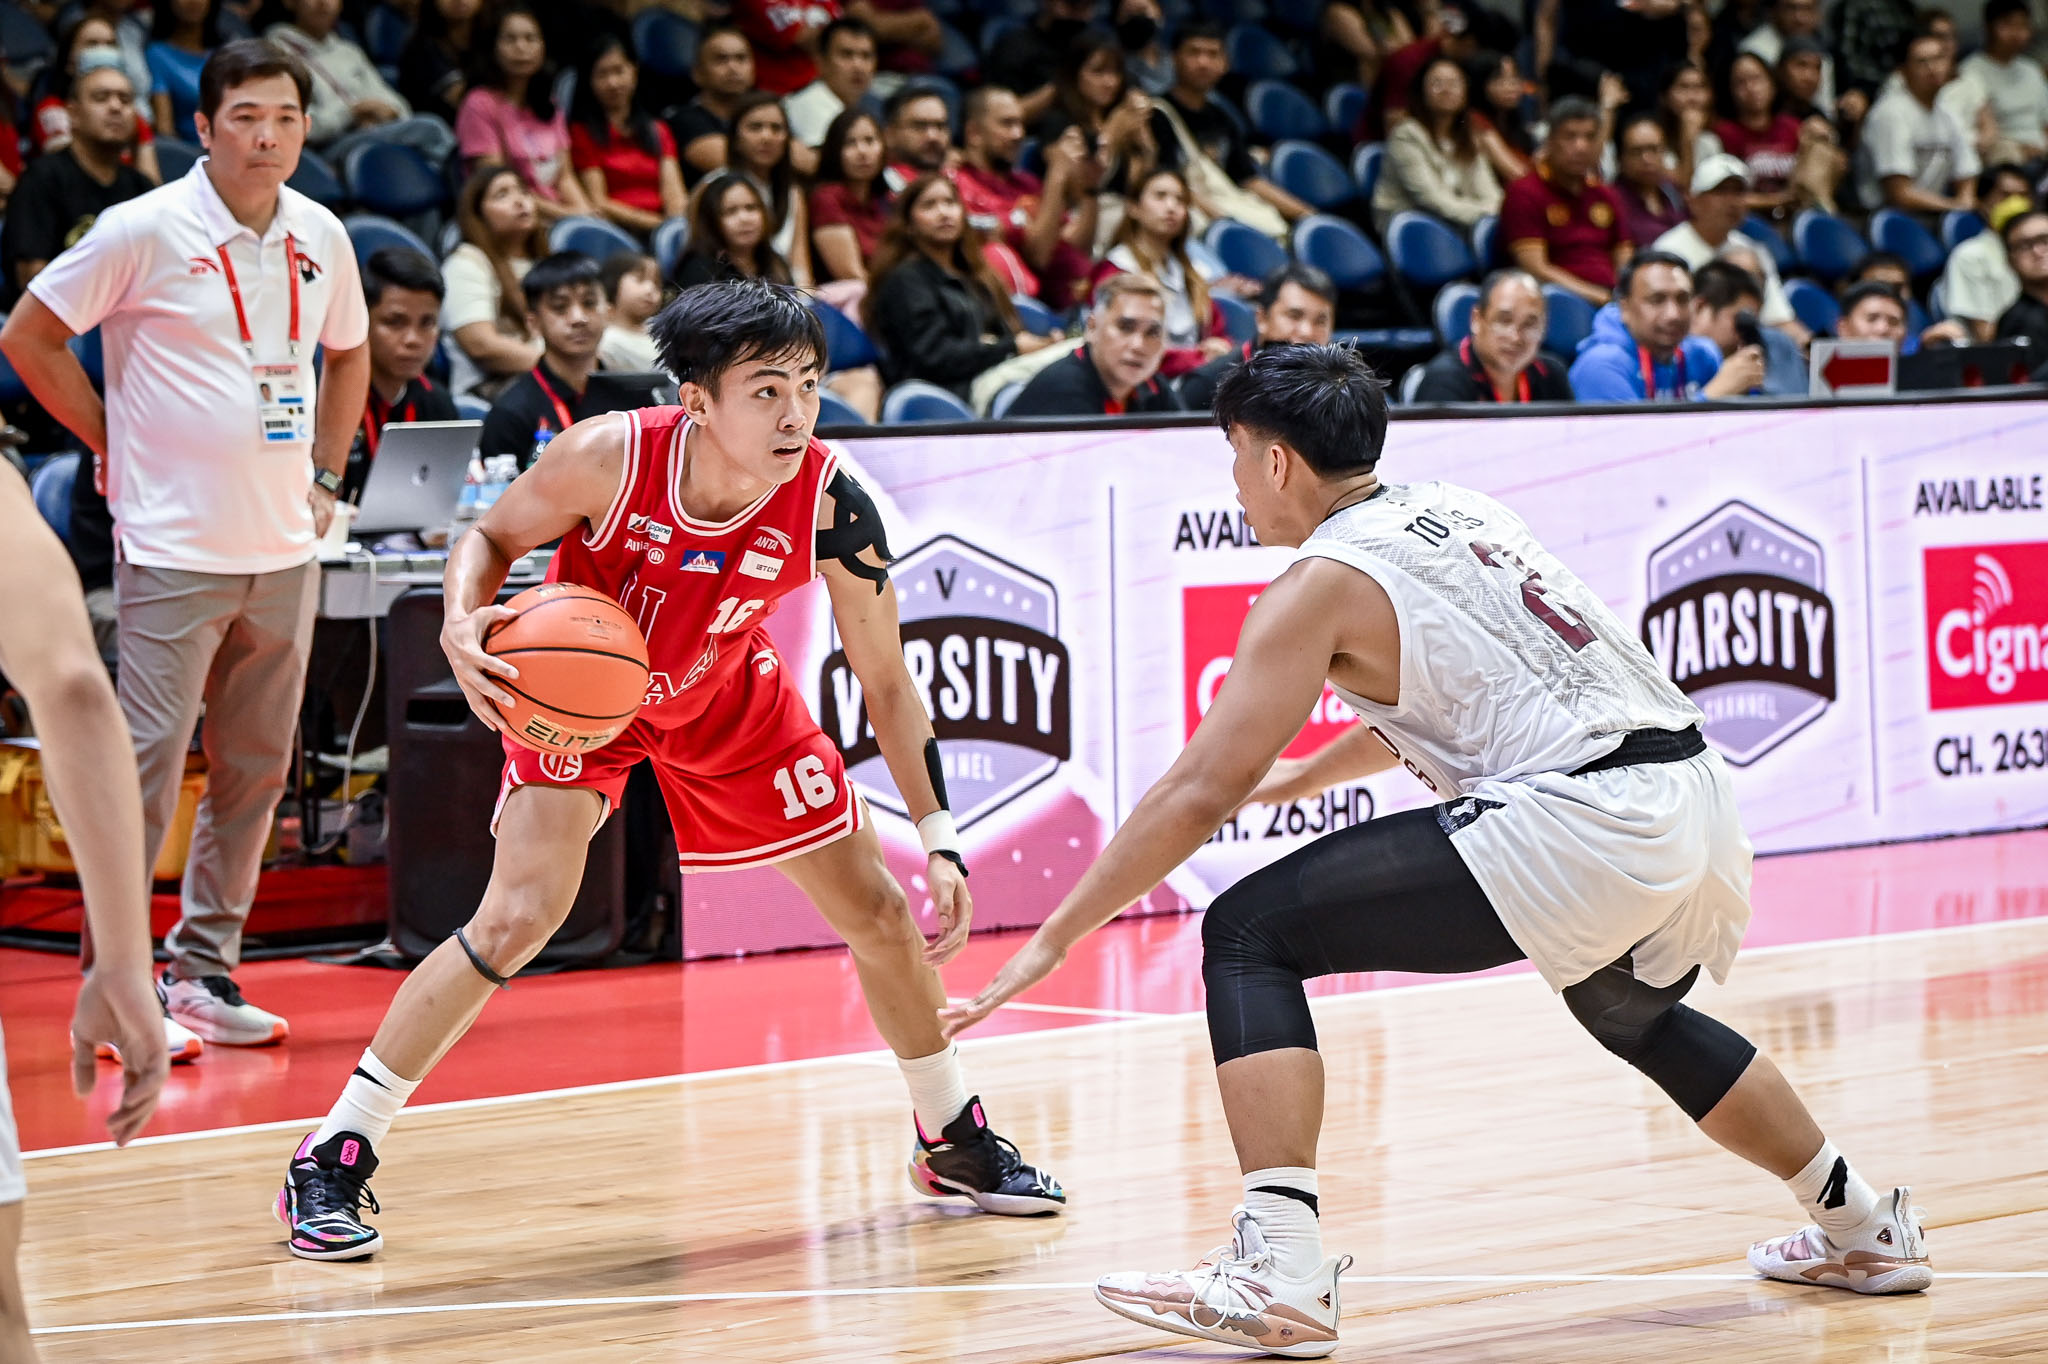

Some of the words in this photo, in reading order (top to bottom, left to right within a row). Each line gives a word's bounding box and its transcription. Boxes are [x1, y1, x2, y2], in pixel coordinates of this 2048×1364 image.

[1914, 476, 2042, 516] AVAILABLE
[624, 538, 650, 552] Allia
[753, 535, 779, 551] ANTA
[1173, 510, 1262, 551] AVAIL
[1726, 527, 1745, 559] V
[934, 567, 957, 601] V
[1469, 539, 1599, 653] 2
[706, 596, 765, 634] 16
[1648, 586, 1828, 682] VARSITY
[1935, 608, 2048, 695] Cign
[831, 634, 1061, 750] VRSITY
[943, 752, 995, 782] NNEL
[1934, 735, 1983, 777] CH.
[1993, 729, 2048, 773] 263
[773, 754, 837, 821] 16
[1263, 786, 1375, 839] 263HD
